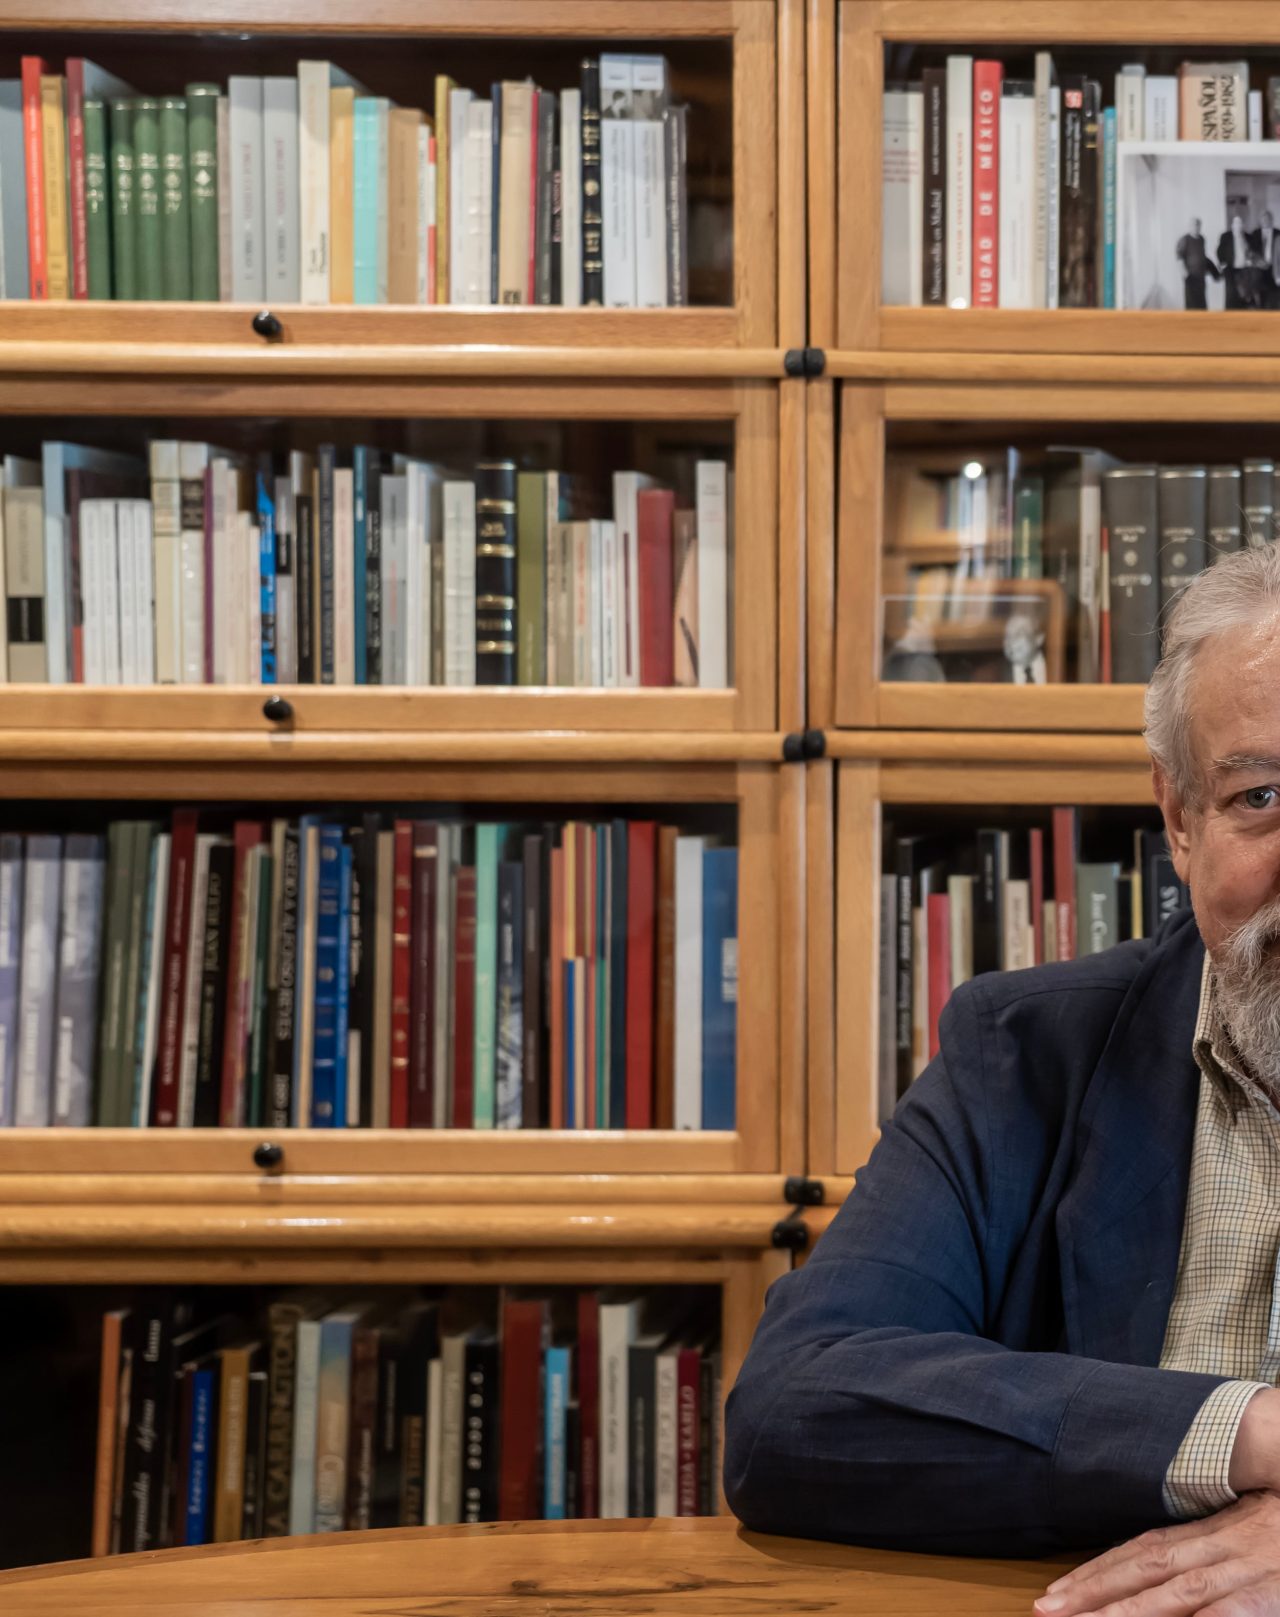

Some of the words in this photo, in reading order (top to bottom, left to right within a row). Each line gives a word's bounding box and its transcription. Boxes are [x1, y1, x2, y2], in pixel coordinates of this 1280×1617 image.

[976, 89, 993, 170] MÉXICO
[1197, 76, 1217, 141] SPAÑOL
[979, 191, 992, 217] DE
[979, 237, 993, 303] IUDAD
